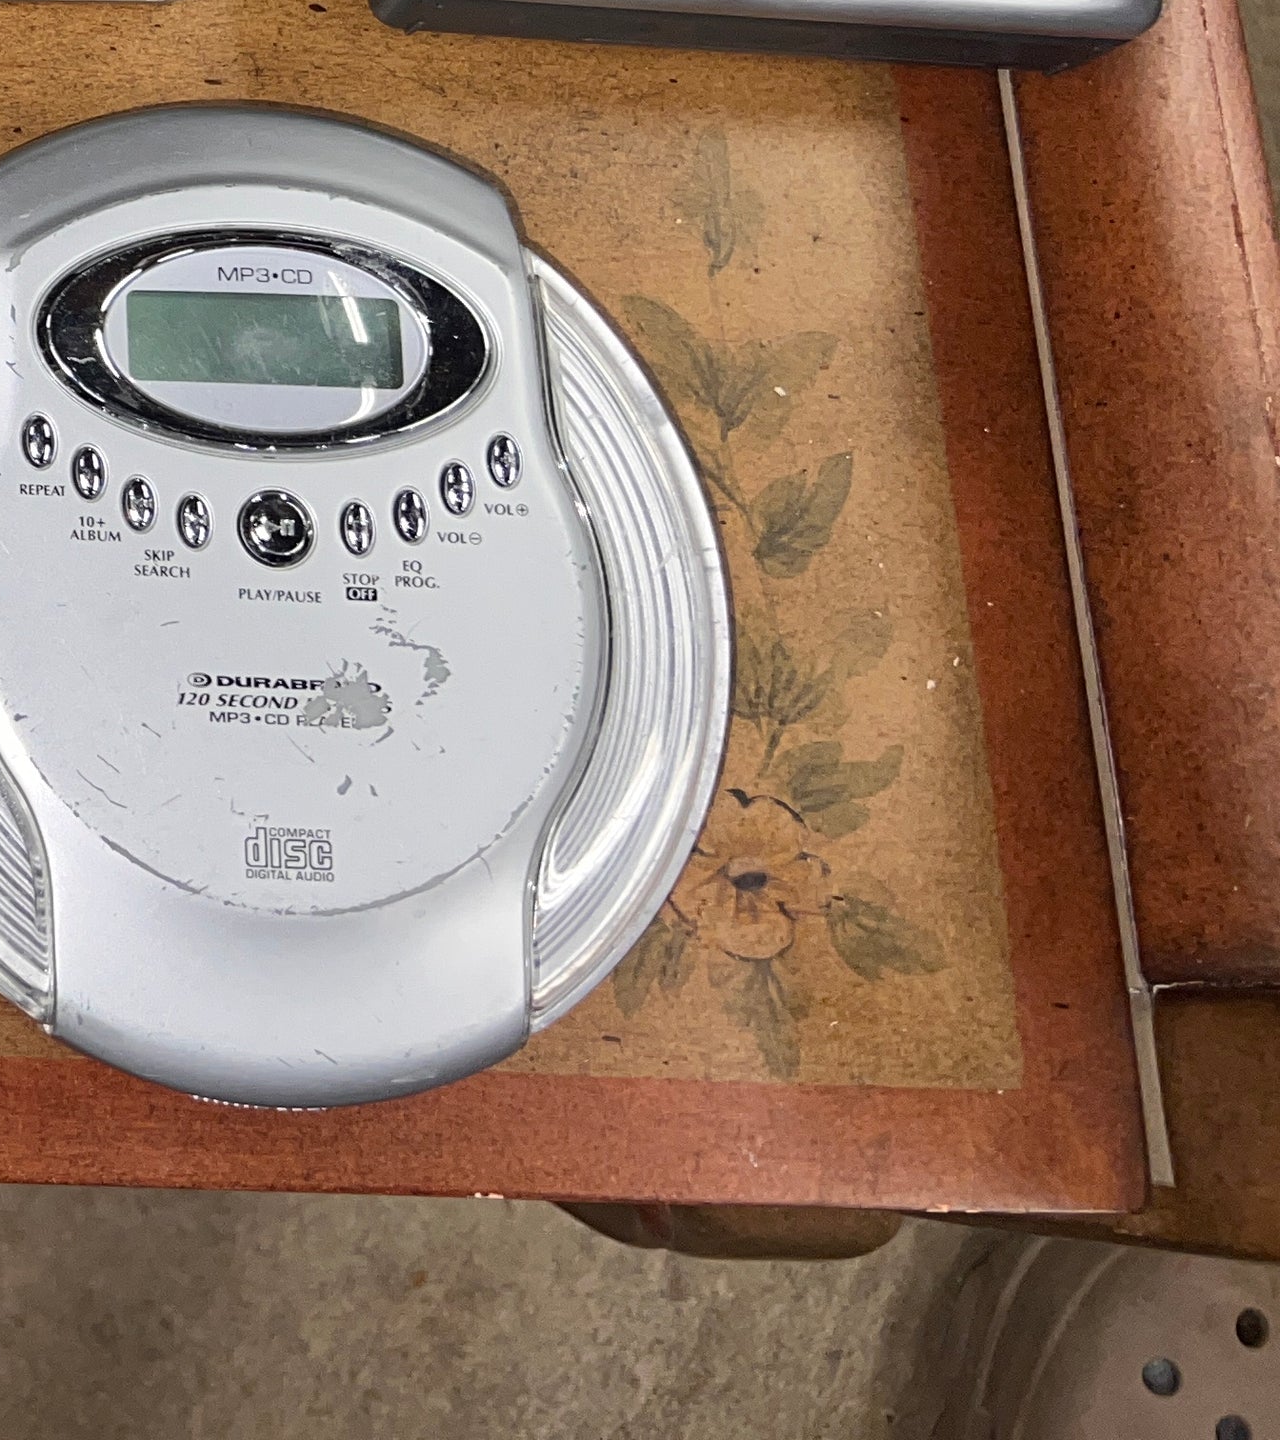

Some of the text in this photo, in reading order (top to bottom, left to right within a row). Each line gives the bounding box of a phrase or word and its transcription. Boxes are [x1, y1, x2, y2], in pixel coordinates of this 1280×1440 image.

[19, 484, 65, 497] REPEAT
[78, 516, 105, 527] 10+
[70, 530, 121, 542] ALBUM
[144, 550, 175, 561] SKIP
[134, 564, 190, 578] SEARCH
[402, 560, 422, 574] EQ
[342, 573, 379, 585] STOP
[395, 576, 440, 588] PROG.
[238, 588, 322, 603] PLAY/PAUSE
[347, 588, 376, 600] OFF
[177, 692, 211, 706] 120
[216, 694, 298, 710] SECOND
[269, 827, 331, 840] COMPACT
[245, 869, 335, 882] DIGITAL AUDIO
